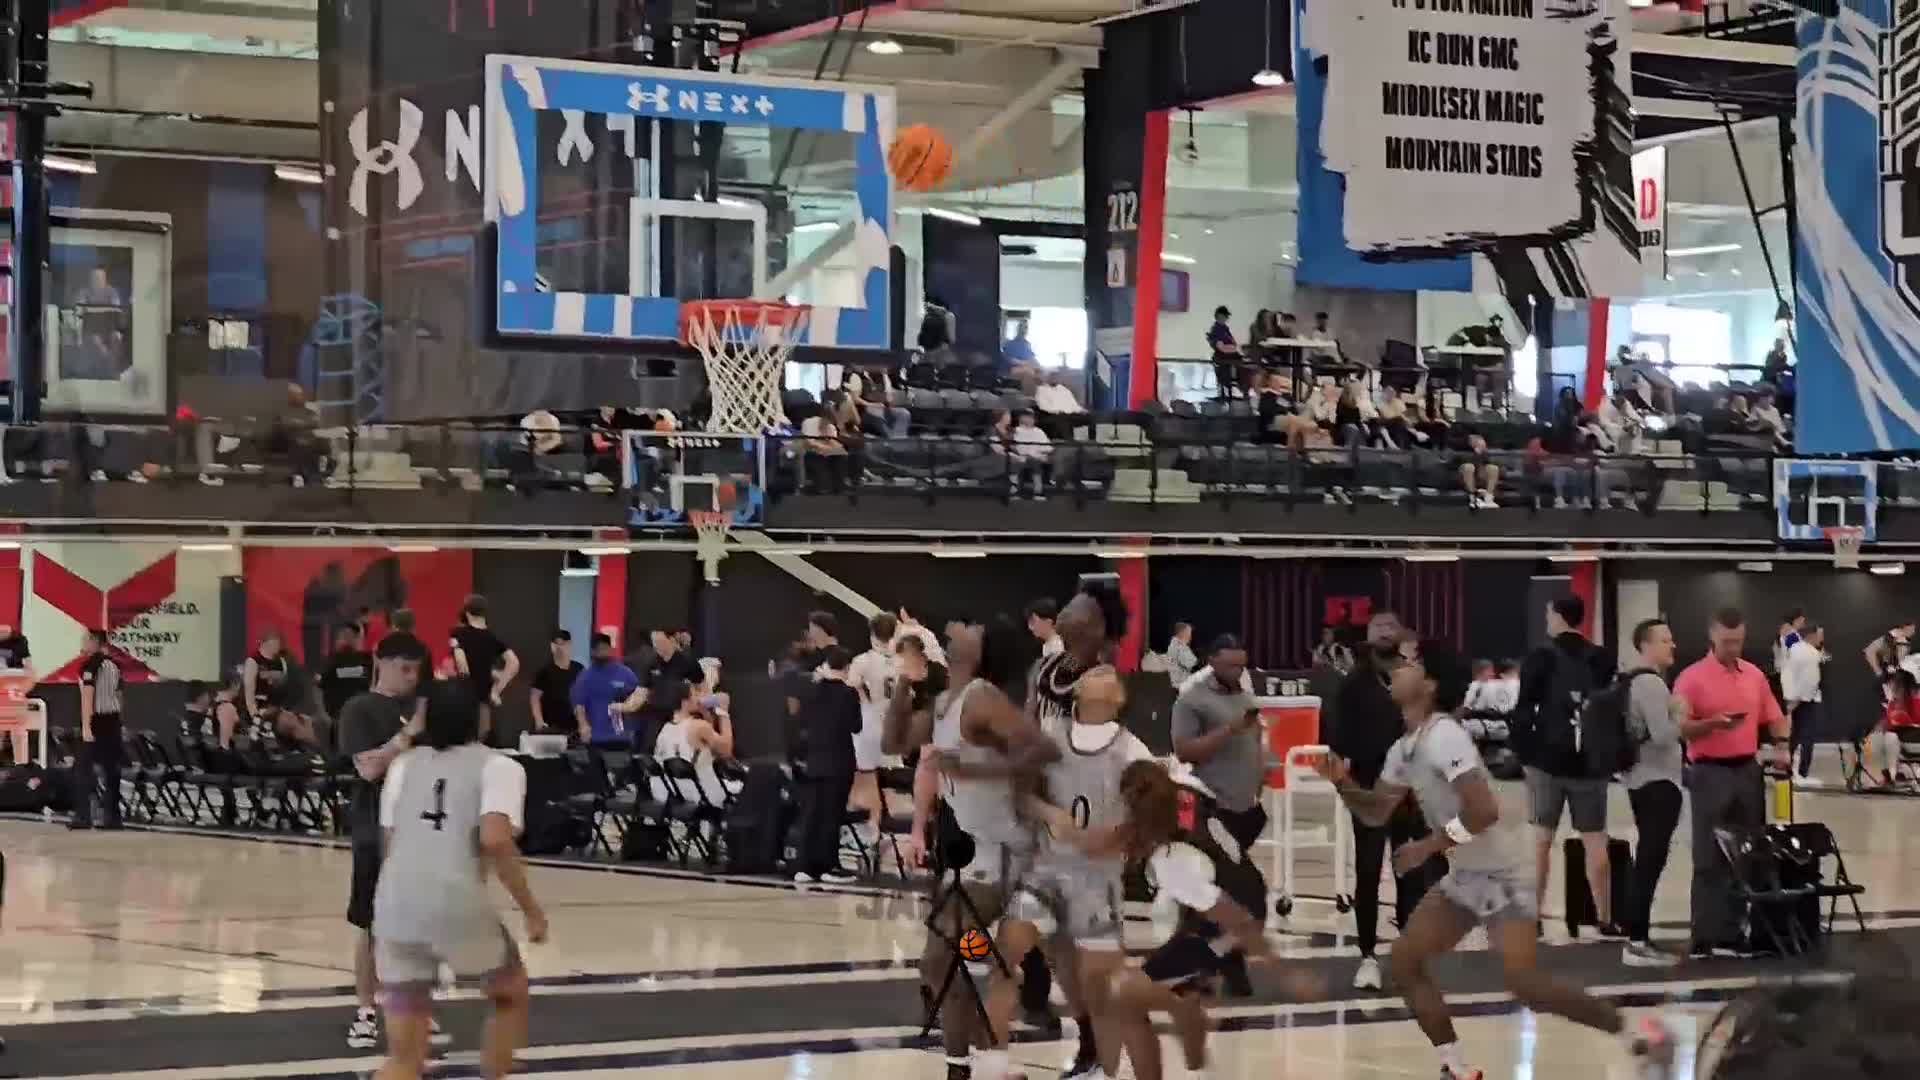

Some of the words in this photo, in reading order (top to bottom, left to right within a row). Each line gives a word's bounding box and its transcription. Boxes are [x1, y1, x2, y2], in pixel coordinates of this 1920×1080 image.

[1408, 30, 1432, 64] KC
[1436, 32, 1474, 67] RUN
[1478, 36, 1519, 71] GMC
[1382, 81, 1480, 121] MIDDLESEX
[1485, 89, 1545, 126] MAGIC
[1385, 136, 1481, 174] MOUNTAIN
[1486, 143, 1543, 178] STARS
[1107, 190, 1138, 232] 212
[420, 778, 448, 831] 4
[1072, 795, 1090, 830] 0
